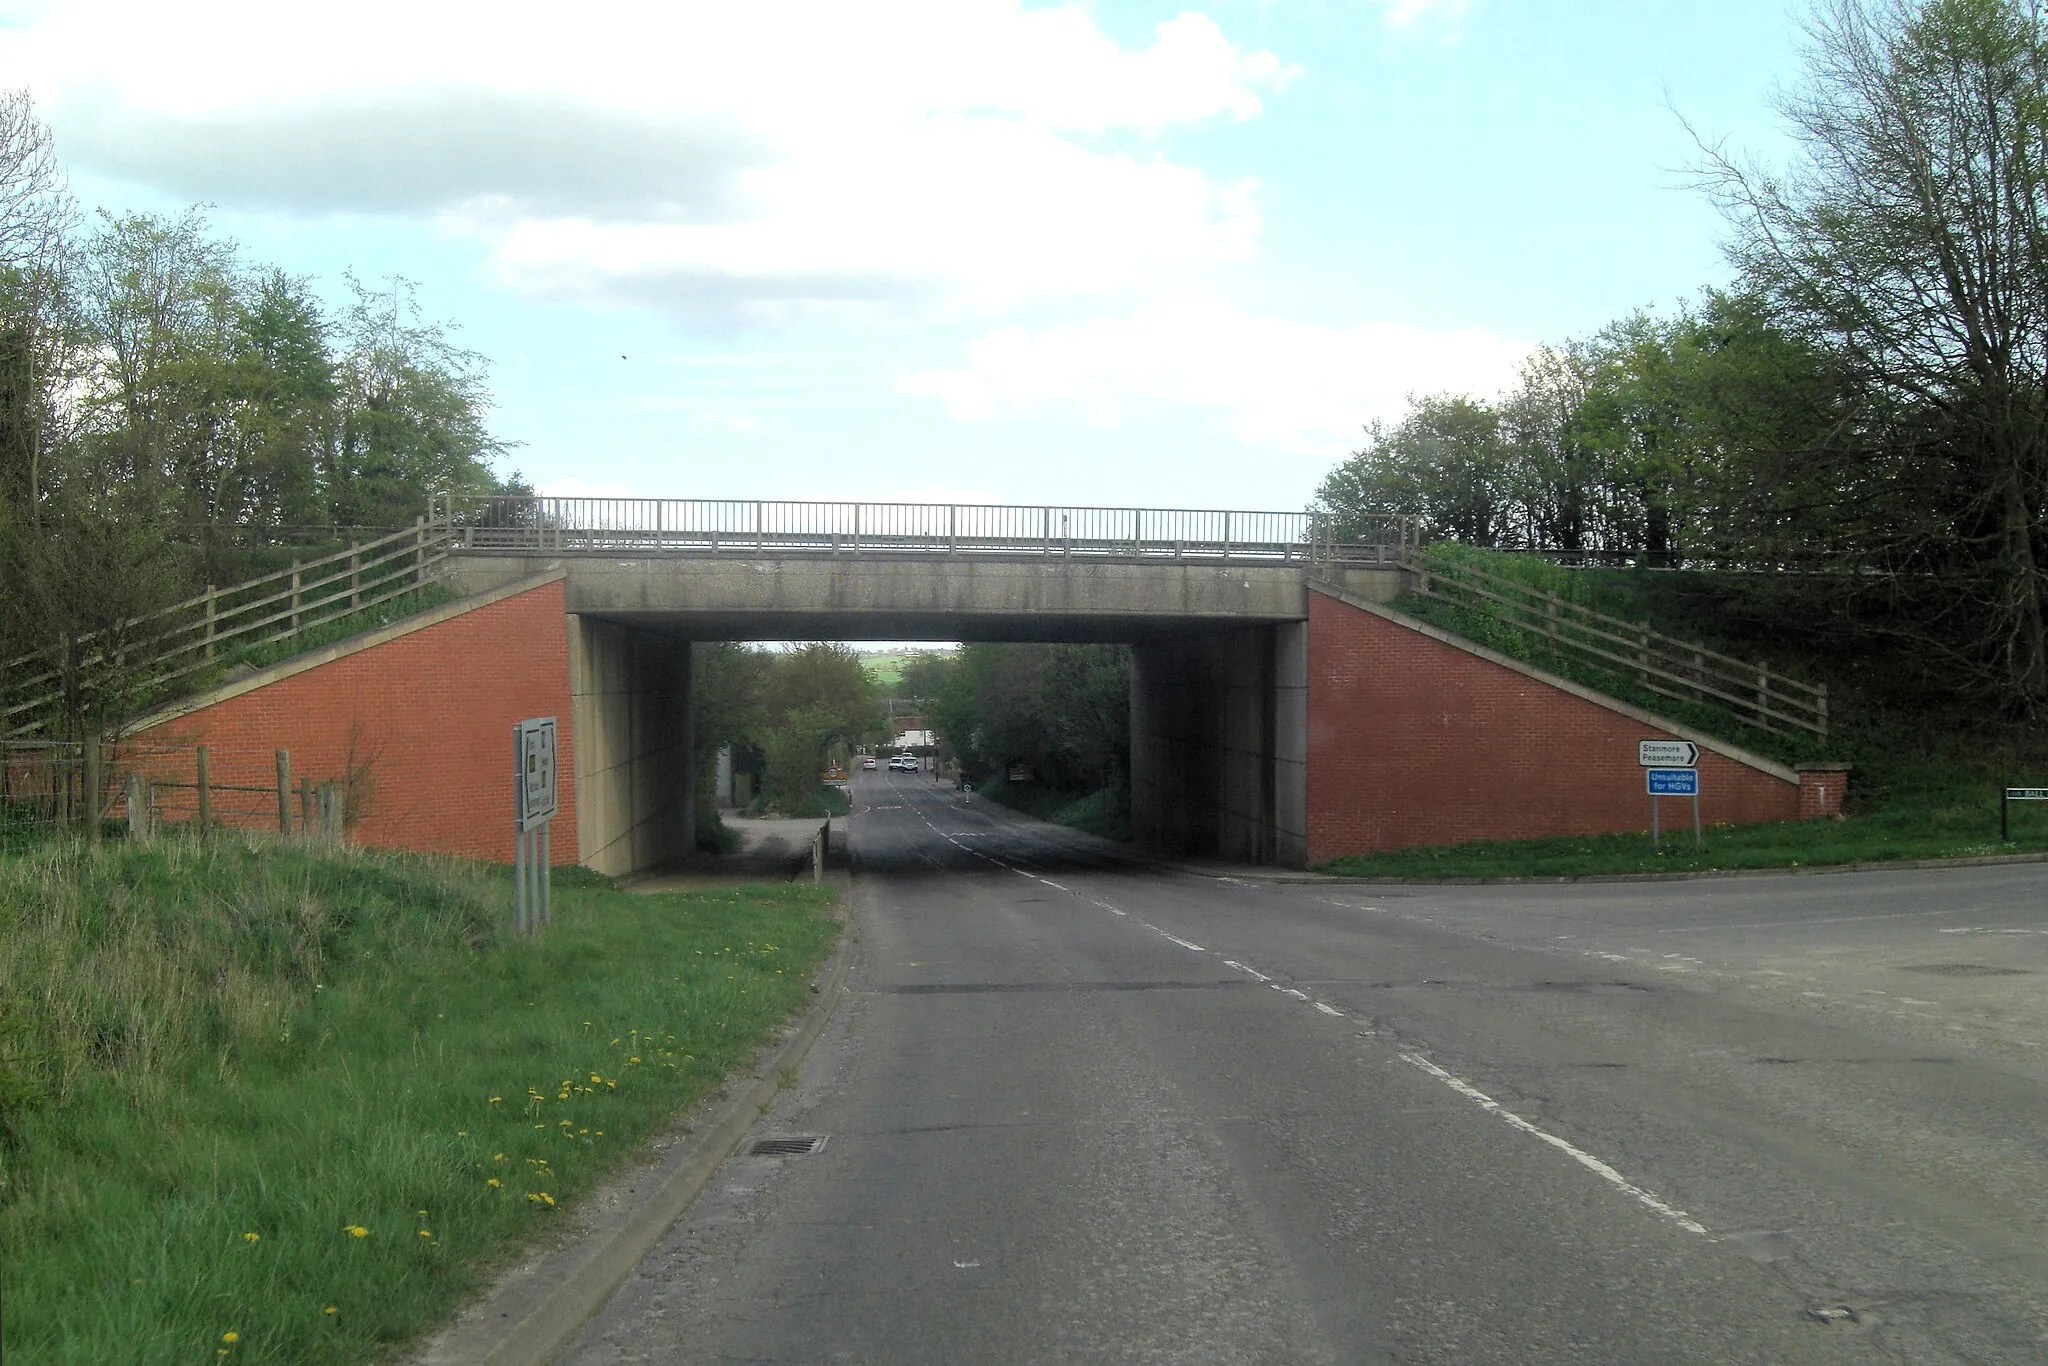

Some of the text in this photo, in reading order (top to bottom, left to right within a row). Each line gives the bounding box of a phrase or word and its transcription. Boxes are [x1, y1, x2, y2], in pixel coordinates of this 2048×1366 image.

[1643, 744, 1680, 752] Stanmore
[1642, 753, 1684, 761] Peasemore
[1651, 773, 1693, 781] Unsuitable
